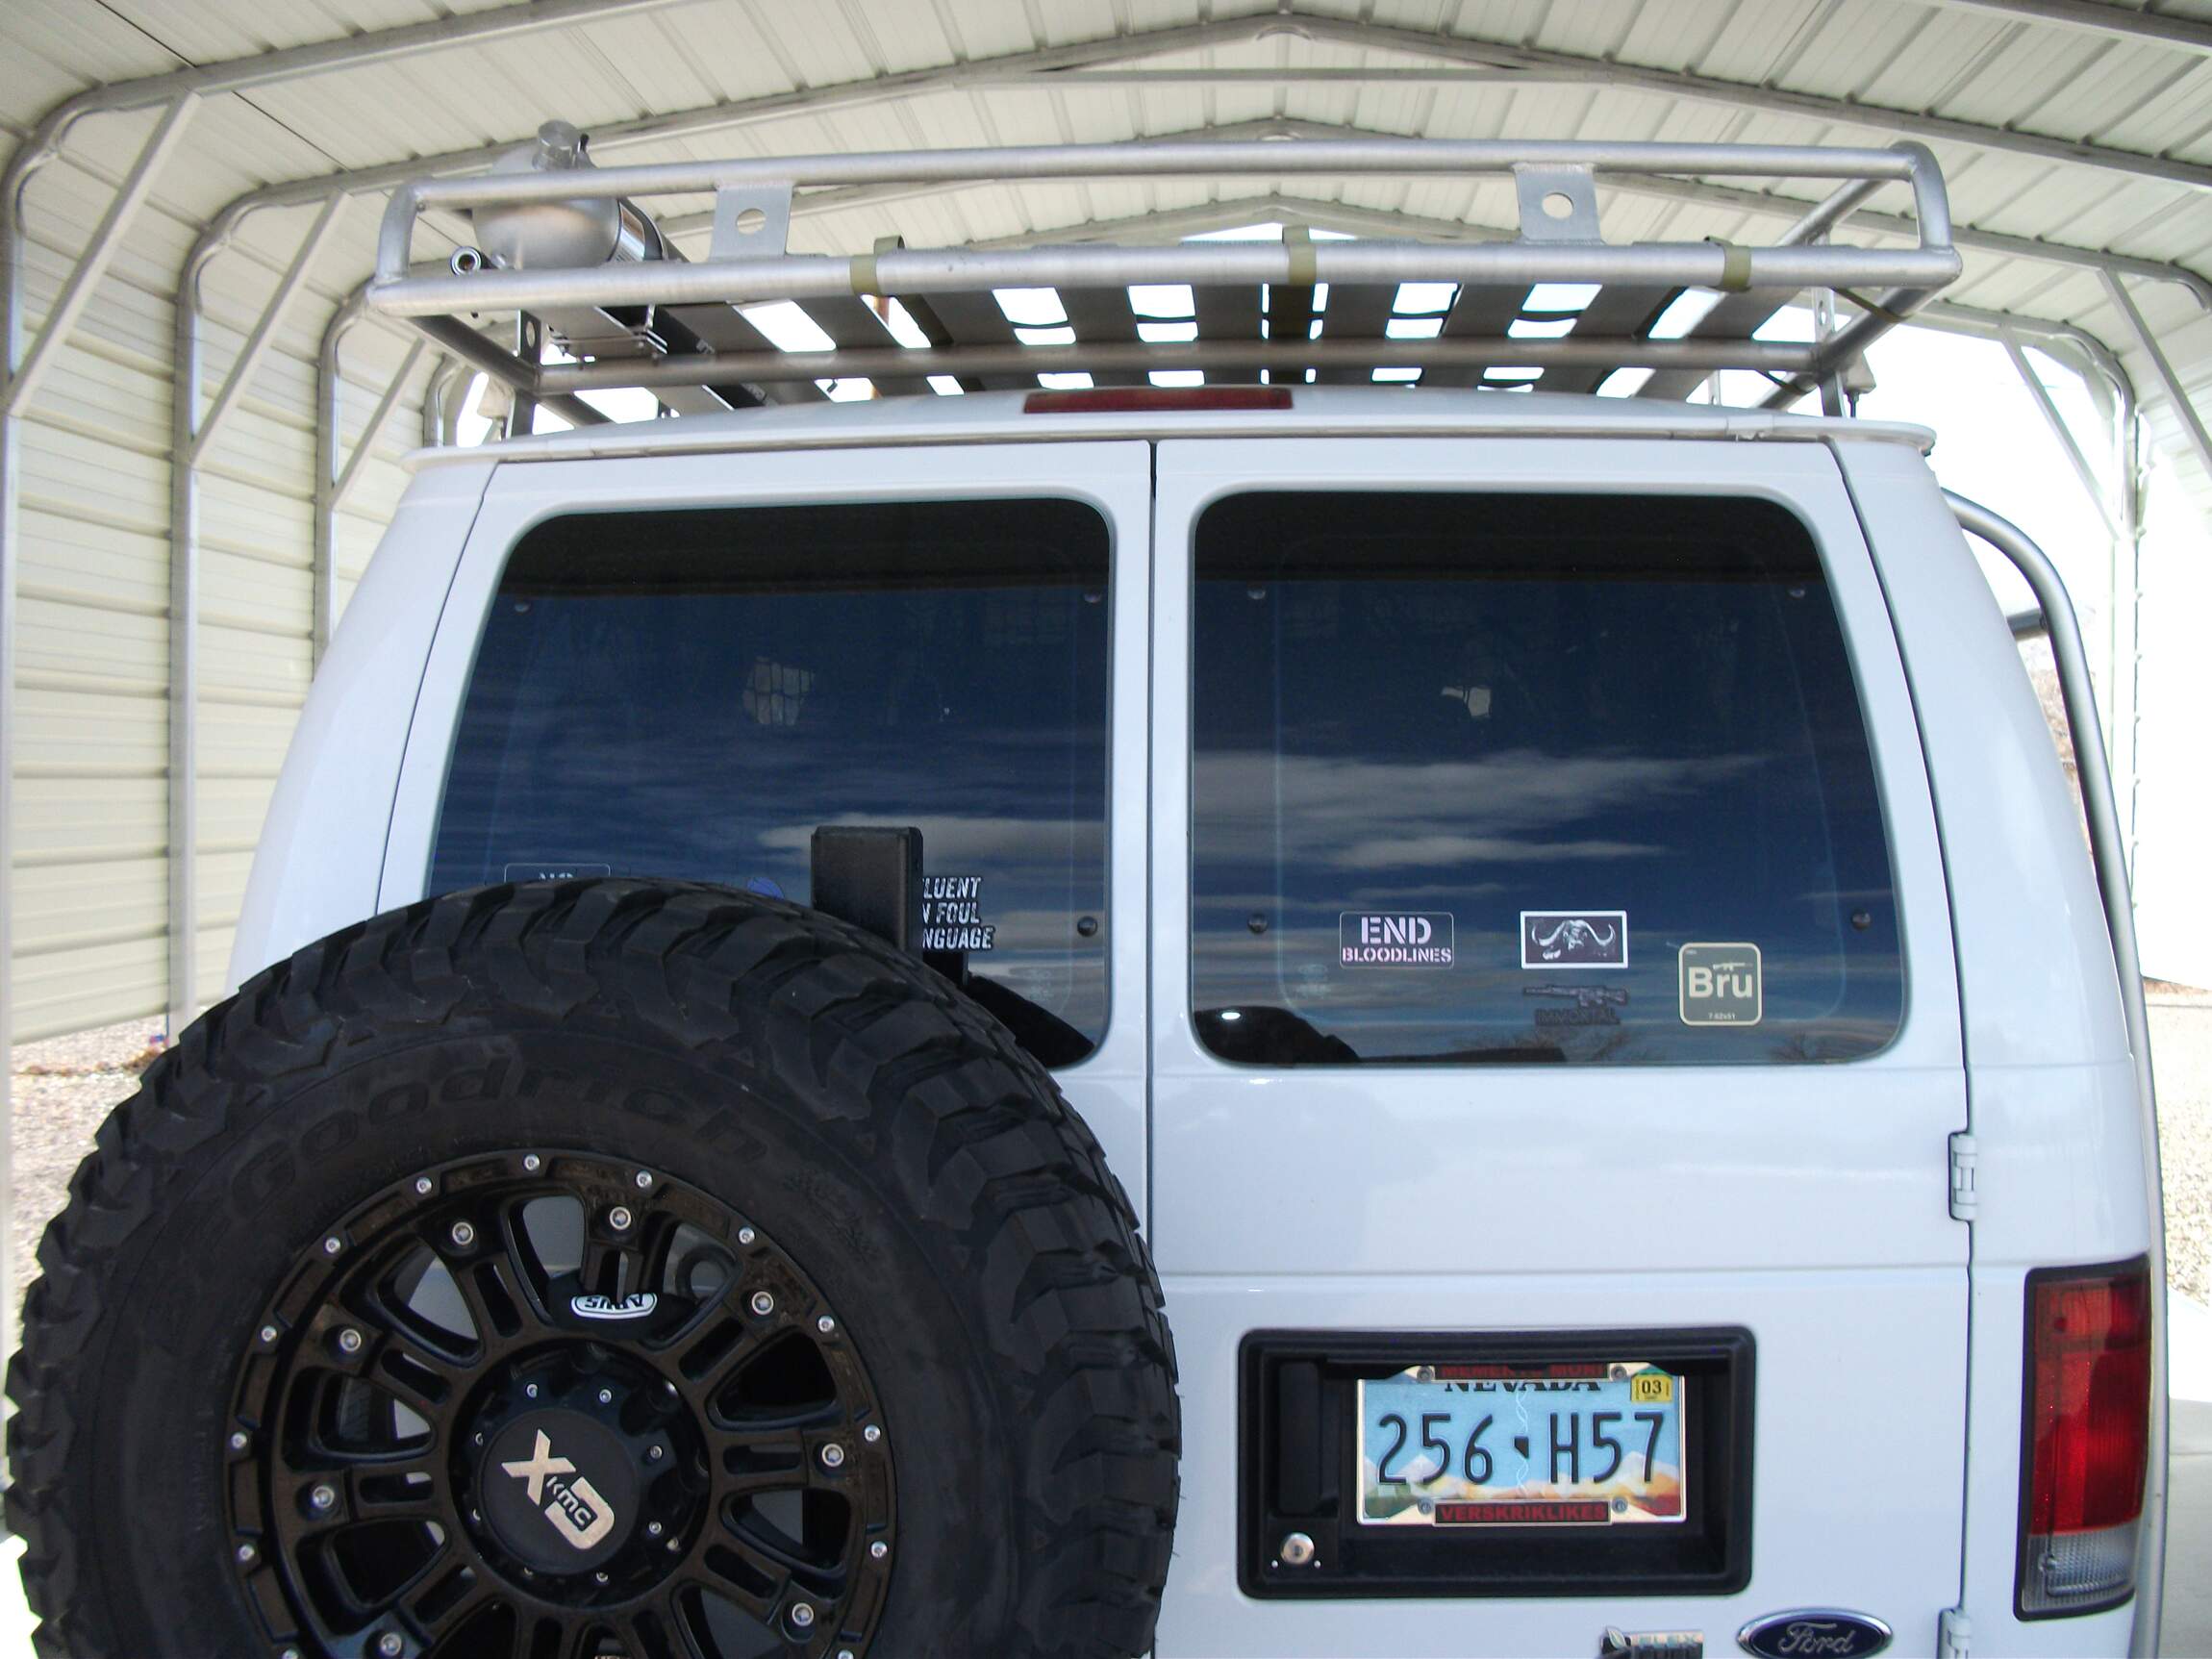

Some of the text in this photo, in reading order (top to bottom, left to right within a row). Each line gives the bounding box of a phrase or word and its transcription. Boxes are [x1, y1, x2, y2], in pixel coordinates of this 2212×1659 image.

[922, 877, 982, 899] LUENT
[936, 901, 980, 924] FOUL
[922, 926, 994, 949] NGUAGE
[1361, 917, 1432, 944] END
[1342, 947, 1453, 963] BLOODLINES
[1688, 966, 1753, 998] Bru
[1641, 1380, 1662, 1395] 03
[1378, 1411, 1664, 1486] 256 H57
[1778, 1621, 1855, 1653] Ford
